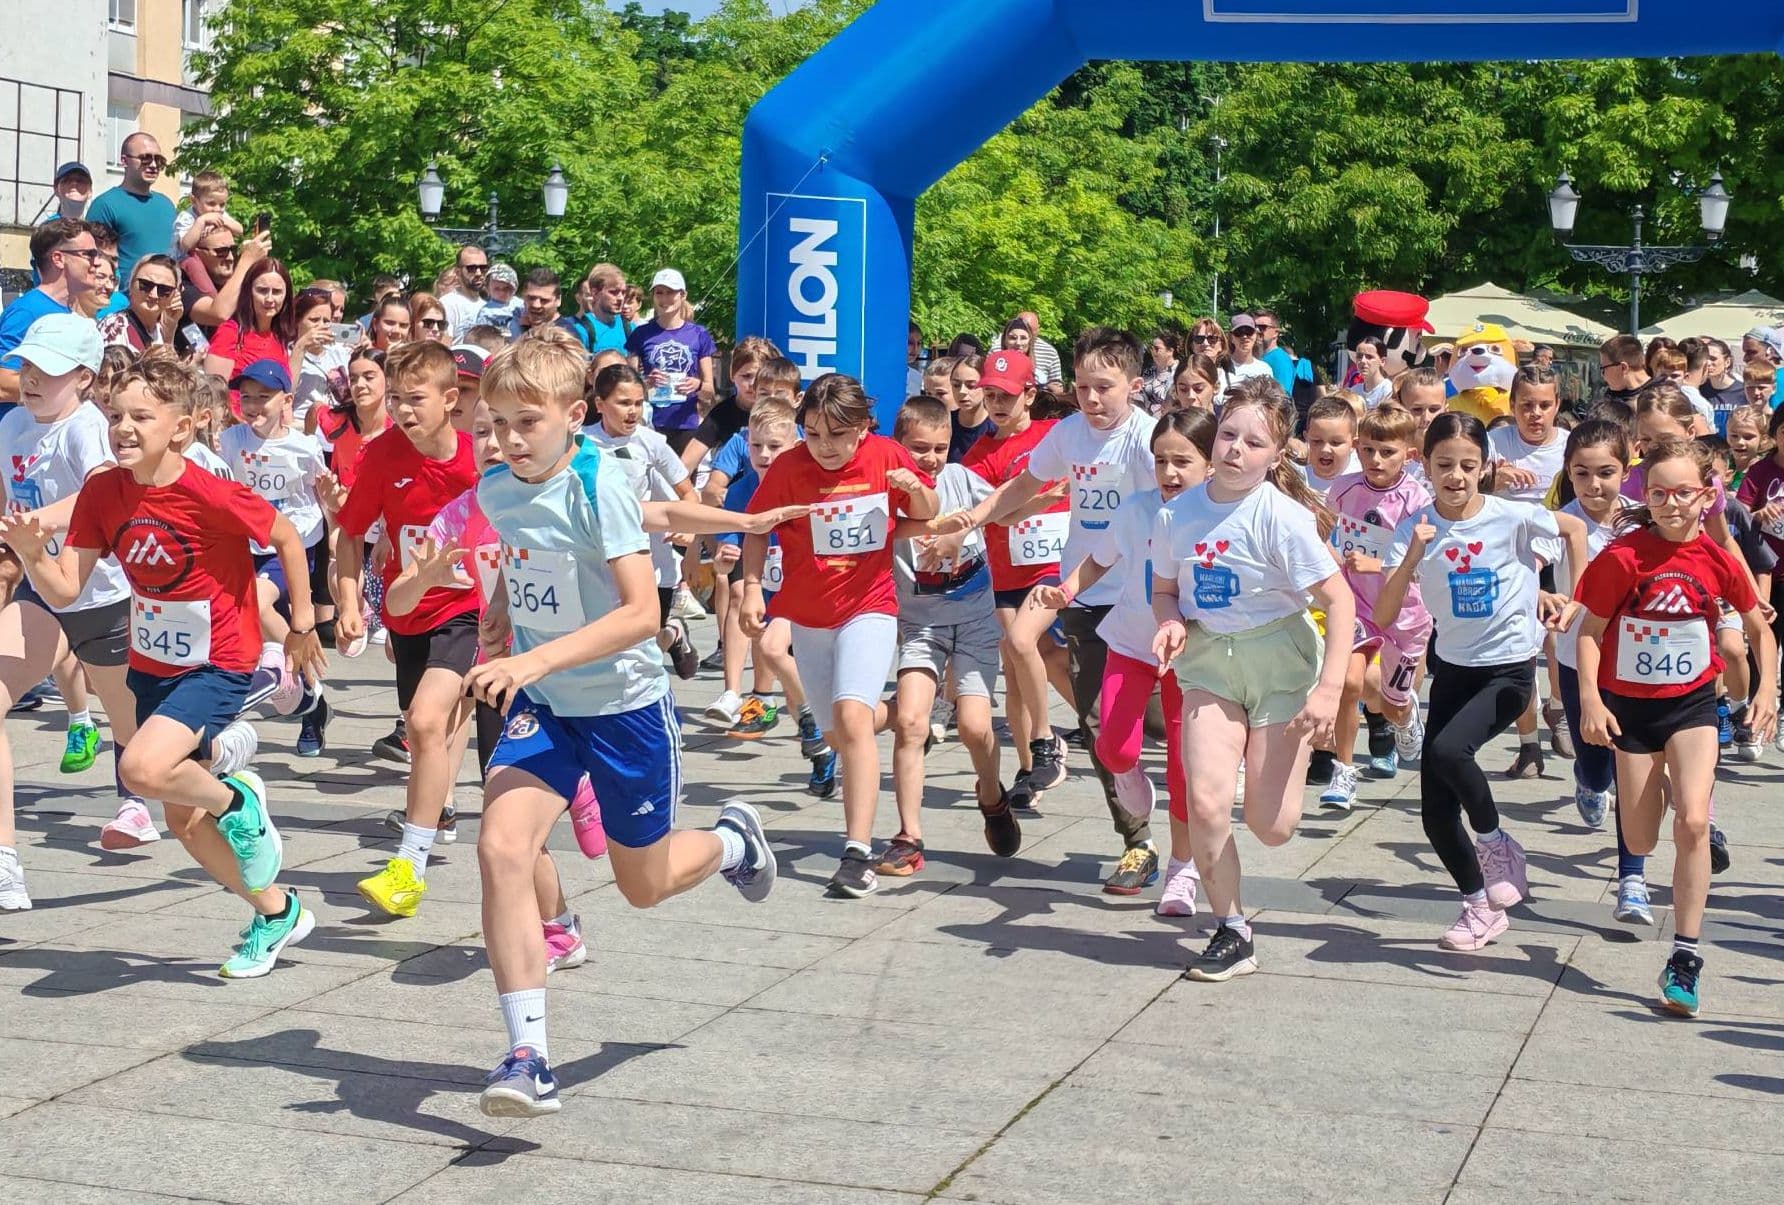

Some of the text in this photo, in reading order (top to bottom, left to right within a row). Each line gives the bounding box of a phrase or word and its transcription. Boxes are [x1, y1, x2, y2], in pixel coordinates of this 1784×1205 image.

[246, 470, 285, 491] 360
[1079, 488, 1121, 510] 220
[829, 524, 877, 549] 851
[1023, 537, 1063, 559] 854
[509, 578, 560, 615] 364
[137, 626, 191, 658] 845
[1635, 651, 1692, 677] 846
[1389, 664, 1416, 691] 10
